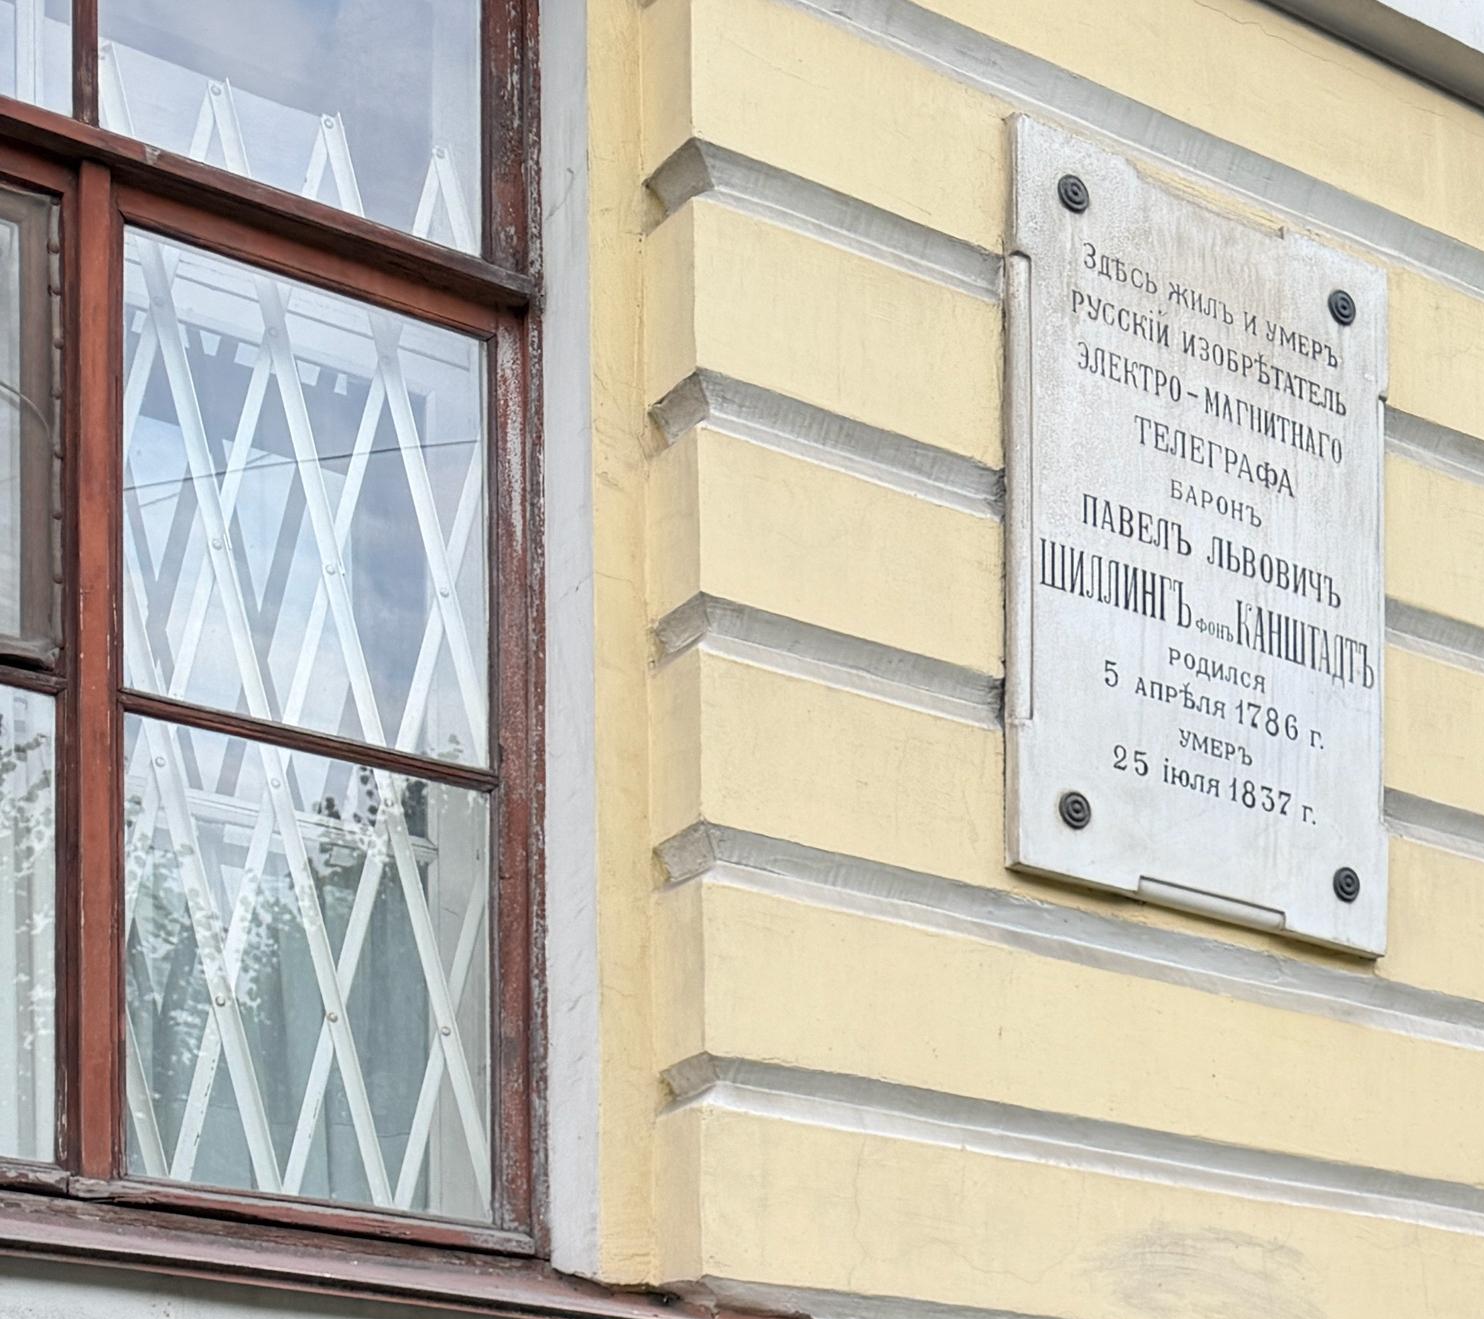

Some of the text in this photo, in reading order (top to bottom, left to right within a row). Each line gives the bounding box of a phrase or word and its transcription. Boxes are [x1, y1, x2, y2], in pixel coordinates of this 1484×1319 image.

[1168, 281, 1234, 326] ЖИЛЪ
[1243, 311, 1258, 336] И
[1265, 320, 1339, 369] УМЕРЪ
[1134, 414, 1296, 498] ТЕЛЕГРАФА
[1170, 478, 1263, 528] БАРОНЪ
[1082, 493, 1342, 609] ПАВЕЛЪ ЛЬВОВИЧЪ
[1039, 537, 1192, 629] ШИЛЛИНГЪ
[1236, 599, 1375, 690] КАНШТАДТЪ
[1104, 659, 1119, 688] 5
[1235, 699, 1299, 741] 1786
[1167, 647, 1266, 694] РОДИЛСЯ
[1113, 744, 1149, 777] 25
[1229, 777, 1292, 816] 1837
[1178, 728, 1253, 767] УМЕРЪ
